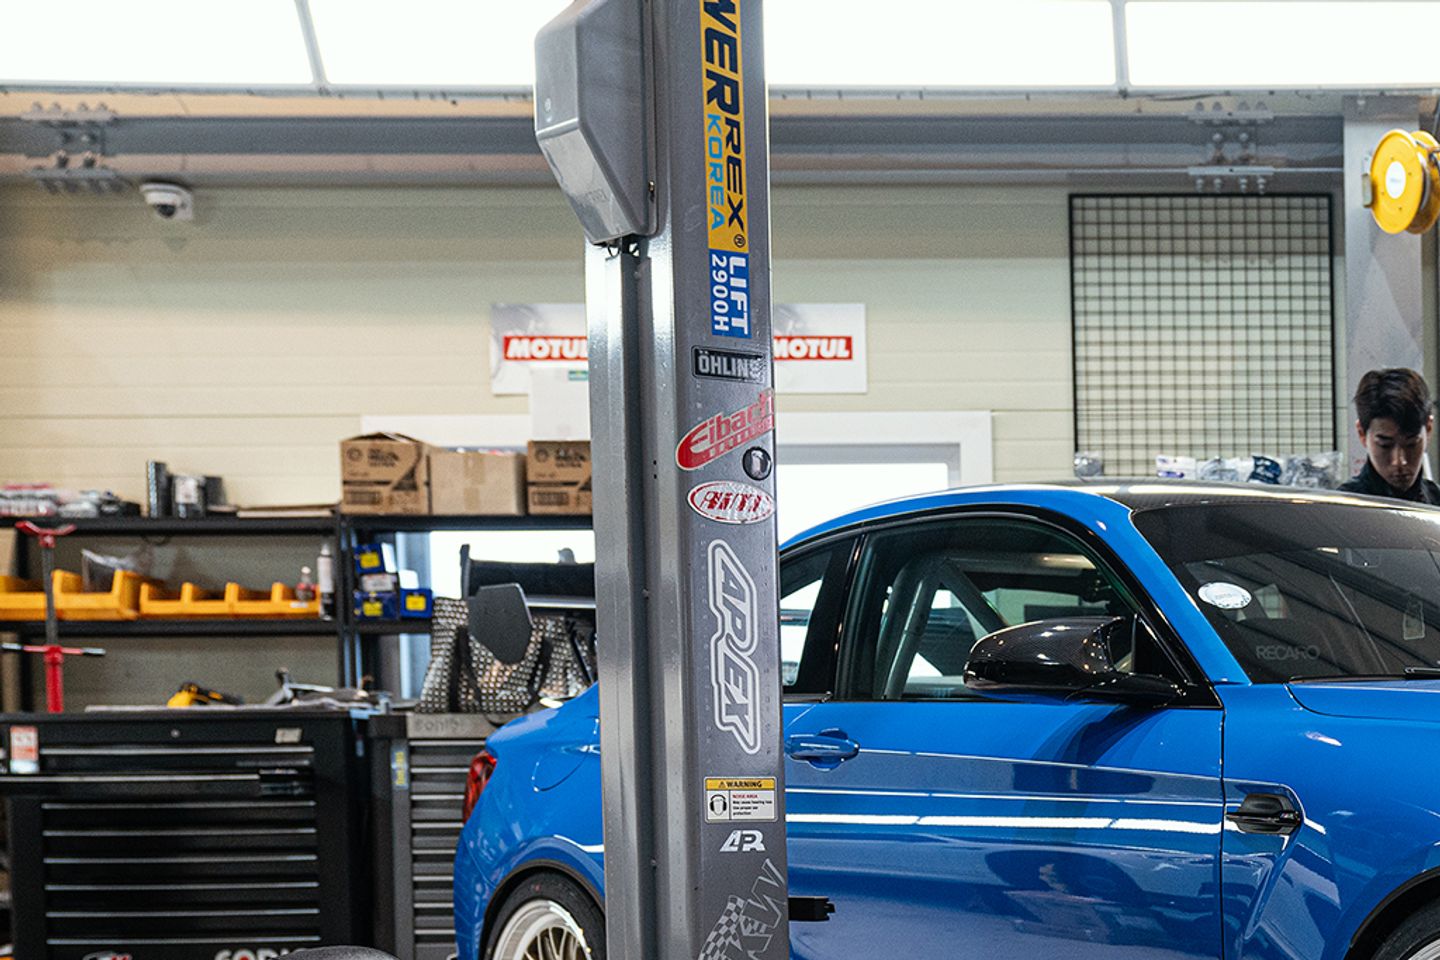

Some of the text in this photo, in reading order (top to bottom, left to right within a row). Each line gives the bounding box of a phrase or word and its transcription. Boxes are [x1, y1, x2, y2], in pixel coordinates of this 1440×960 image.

[707, 113, 724, 230] KOREA
[712, 254, 729, 331] 2900H
[729, 256, 748, 335] LIFT
[714, 545, 756, 748] APEX
